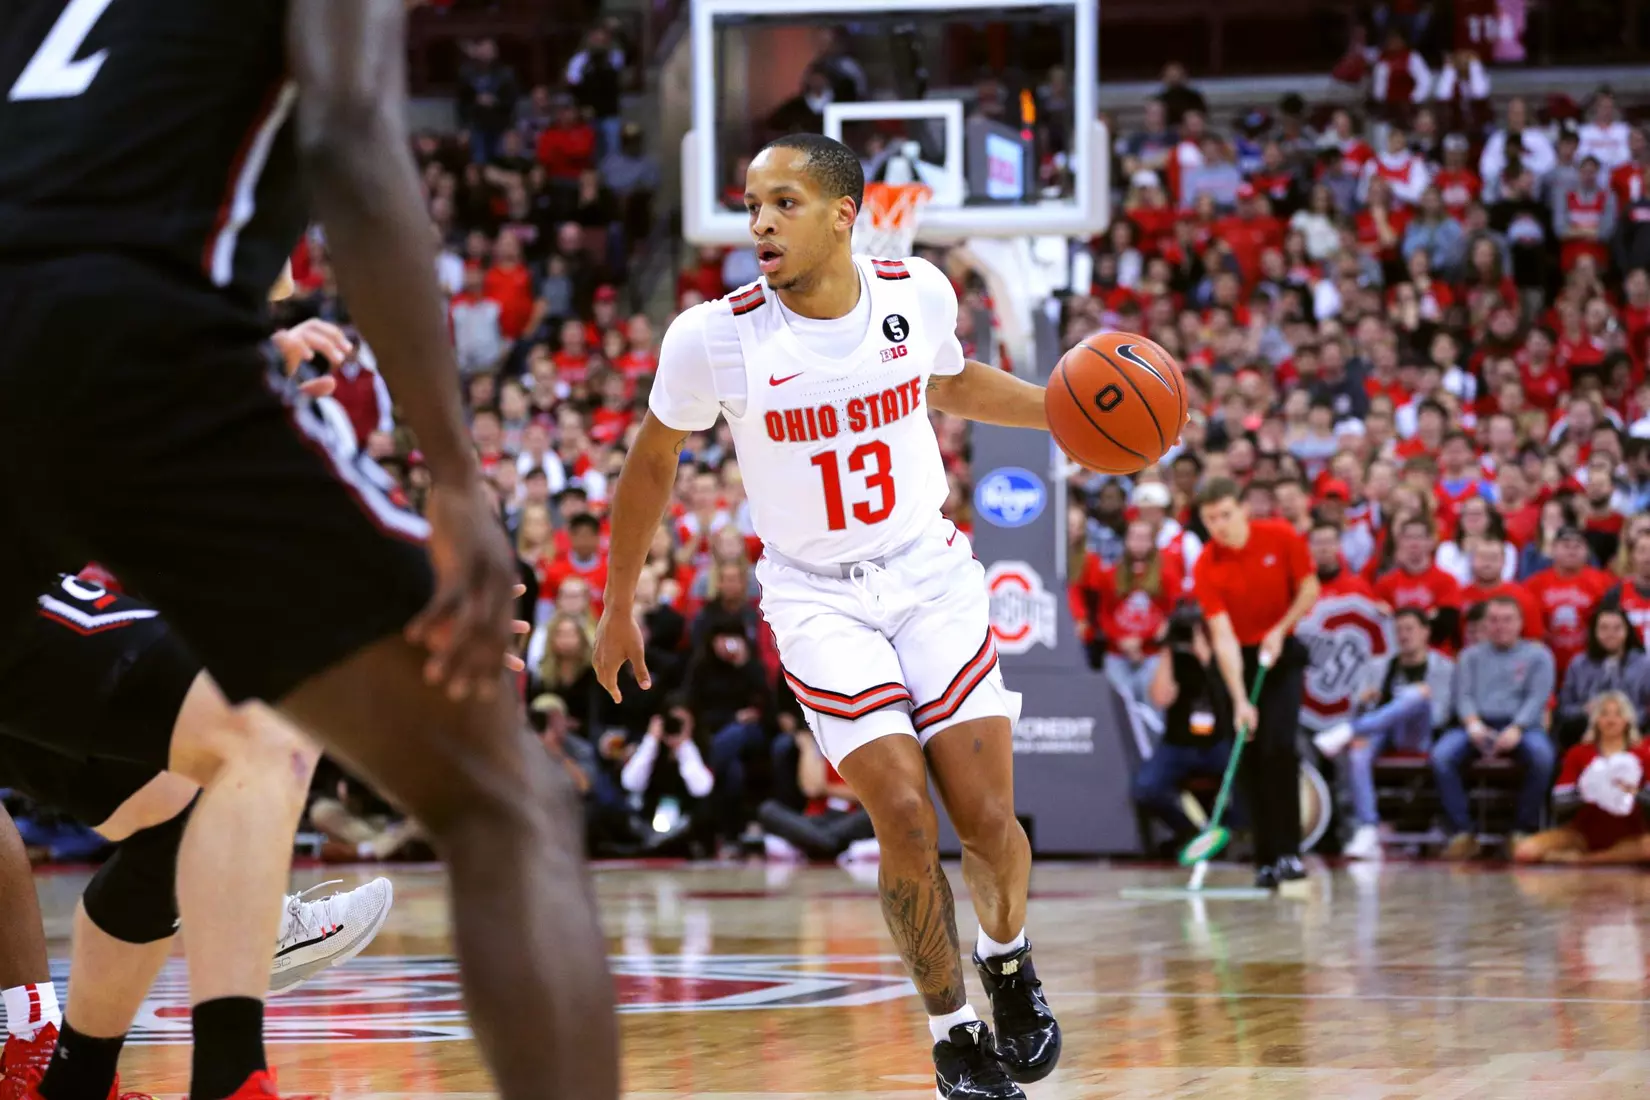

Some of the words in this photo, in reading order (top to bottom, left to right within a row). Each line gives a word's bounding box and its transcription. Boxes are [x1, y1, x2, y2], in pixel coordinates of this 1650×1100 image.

[888, 319, 905, 341] 5
[764, 404, 838, 442] OHIO
[846, 375, 921, 433] STATE
[810, 439, 896, 531] 13
